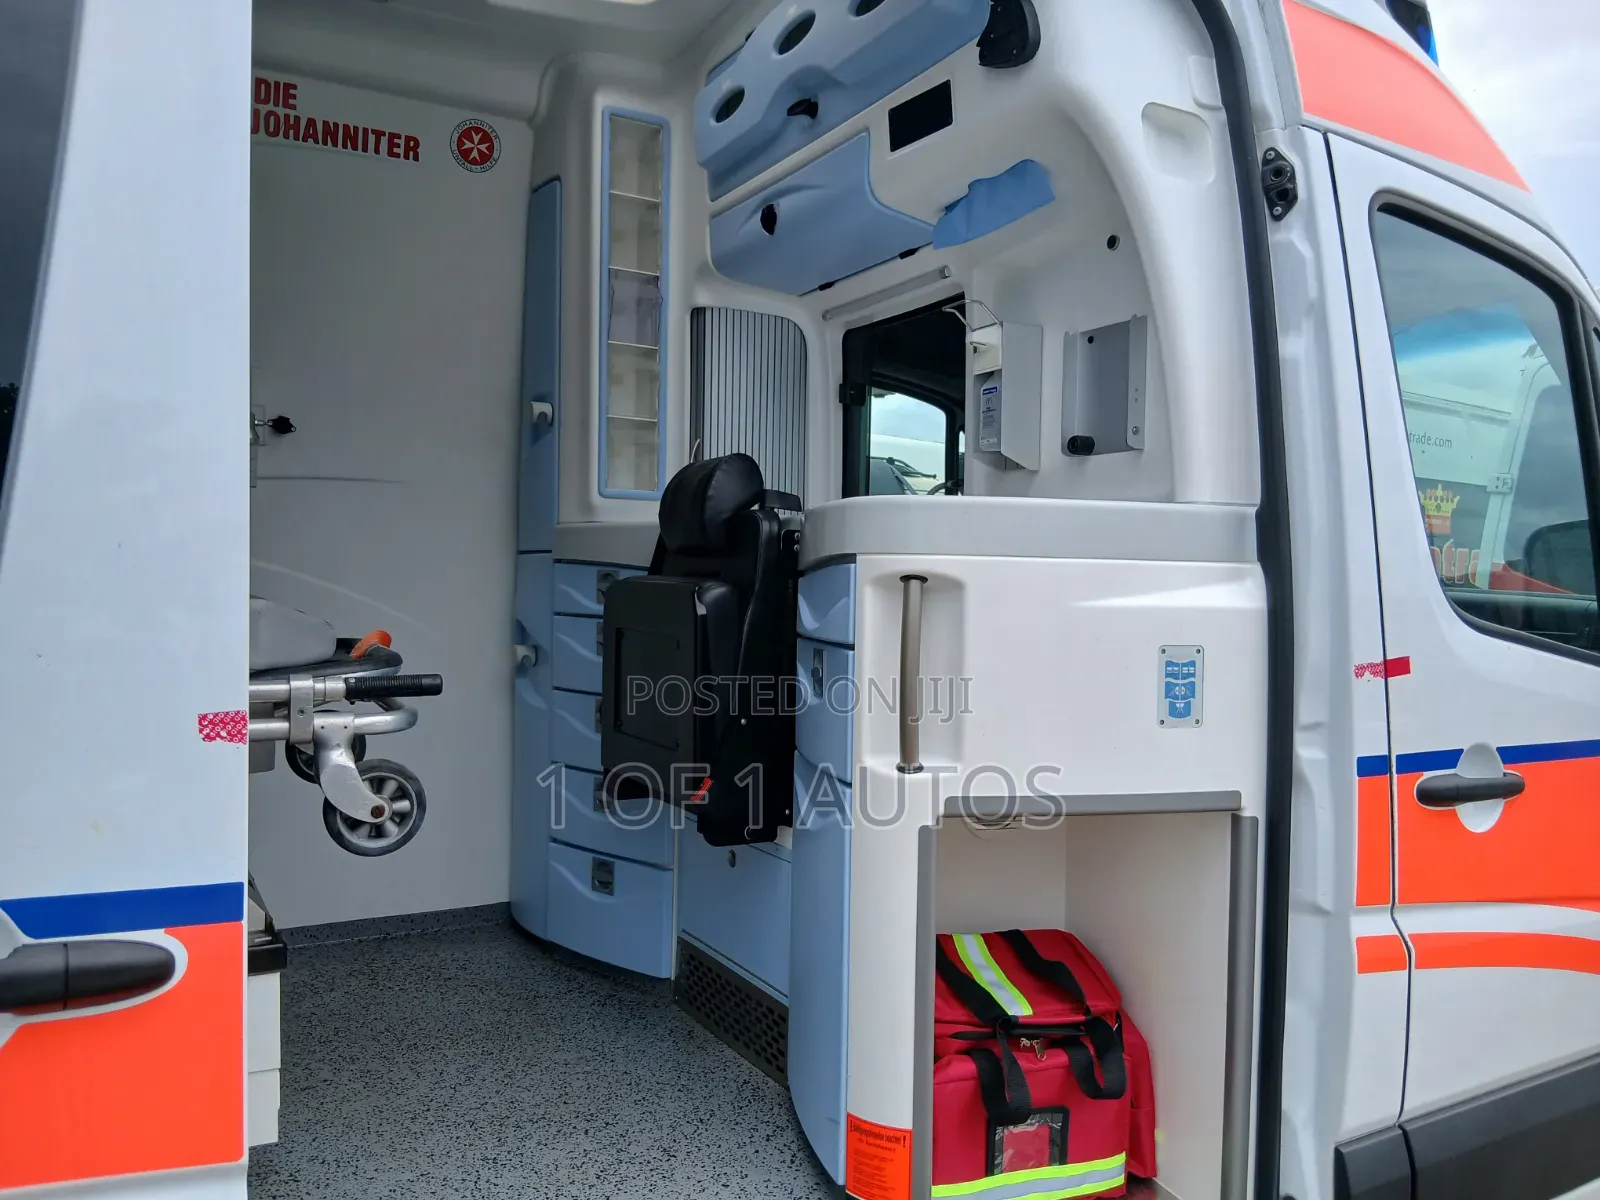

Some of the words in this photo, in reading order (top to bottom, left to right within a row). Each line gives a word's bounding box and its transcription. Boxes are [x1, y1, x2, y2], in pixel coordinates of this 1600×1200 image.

[254, 77, 298, 110] DIE
[251, 107, 421, 162] JOHANNITER
[456, 120, 499, 141] JOHANNITER
